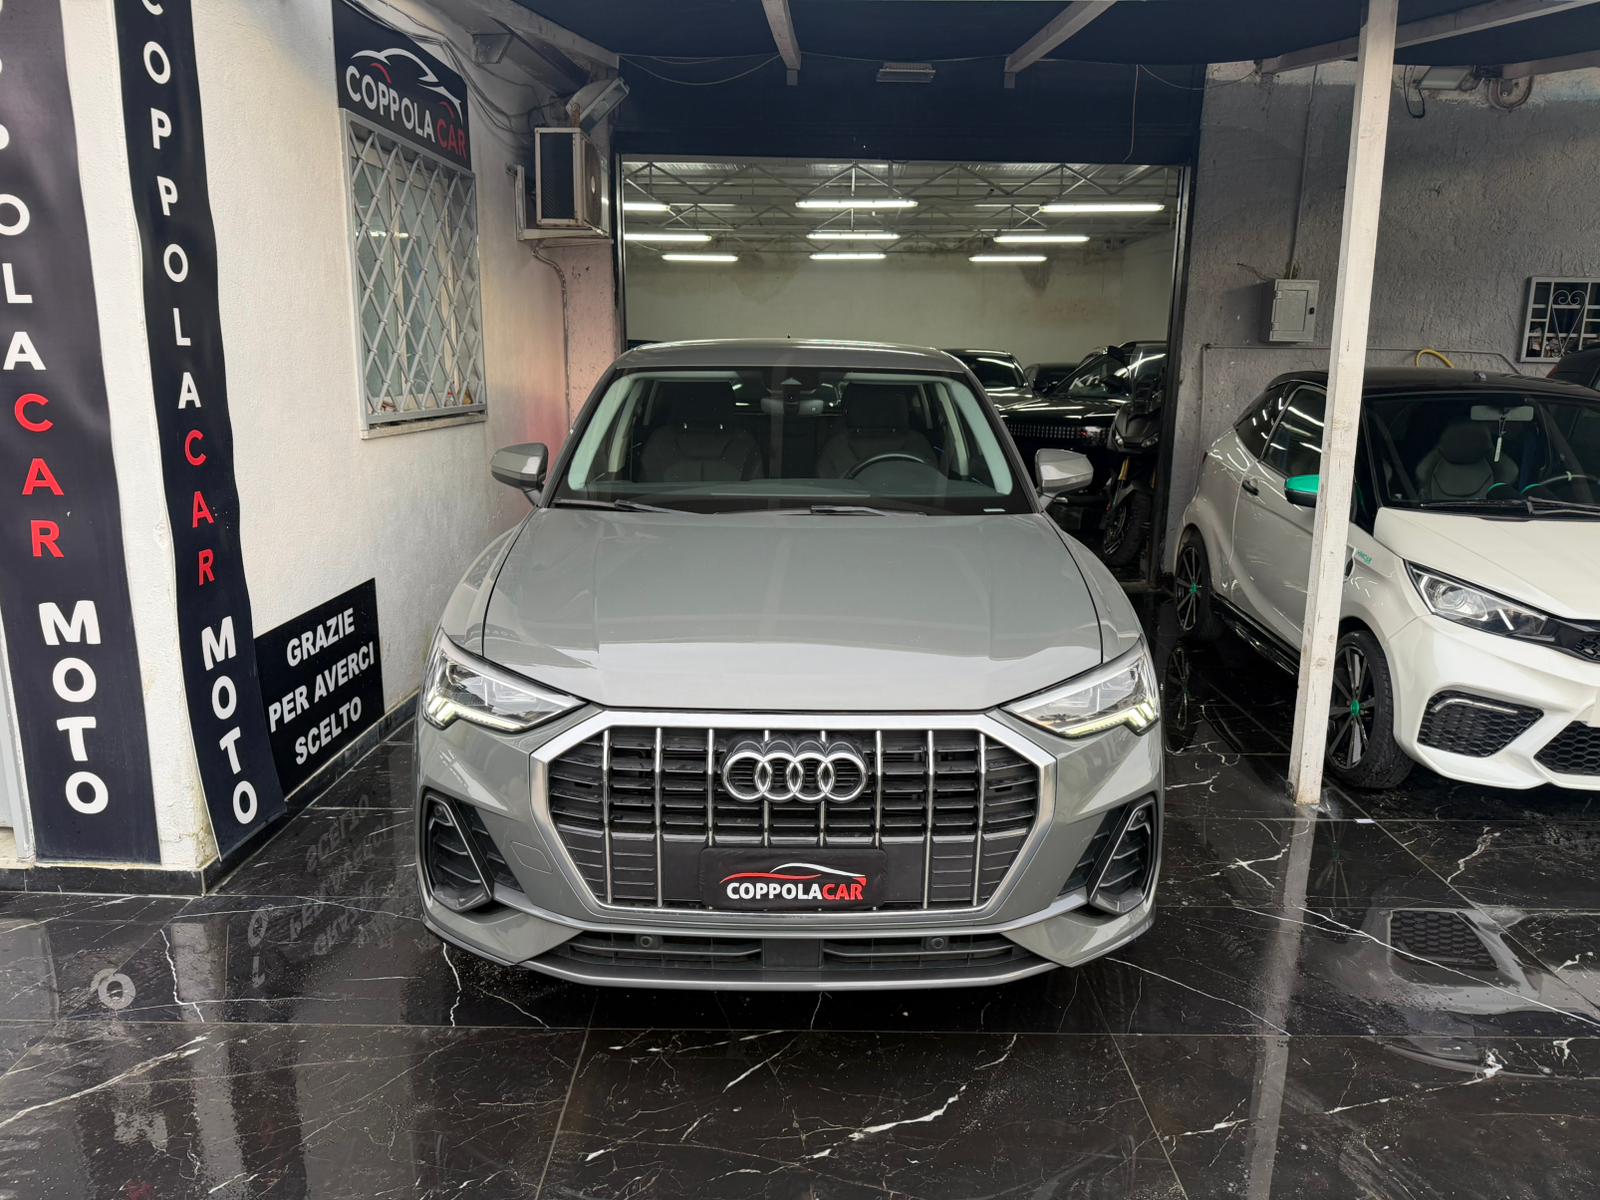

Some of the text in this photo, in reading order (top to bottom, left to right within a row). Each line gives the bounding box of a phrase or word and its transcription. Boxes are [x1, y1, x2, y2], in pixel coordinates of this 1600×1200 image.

[286, 607, 355, 667] GRAZIE
[38, 600, 109, 815] MOTO
[201, 616, 258, 824] MOTO
[268, 641, 375, 733] PER AVERCI
[295, 696, 362, 765] SCELTO
